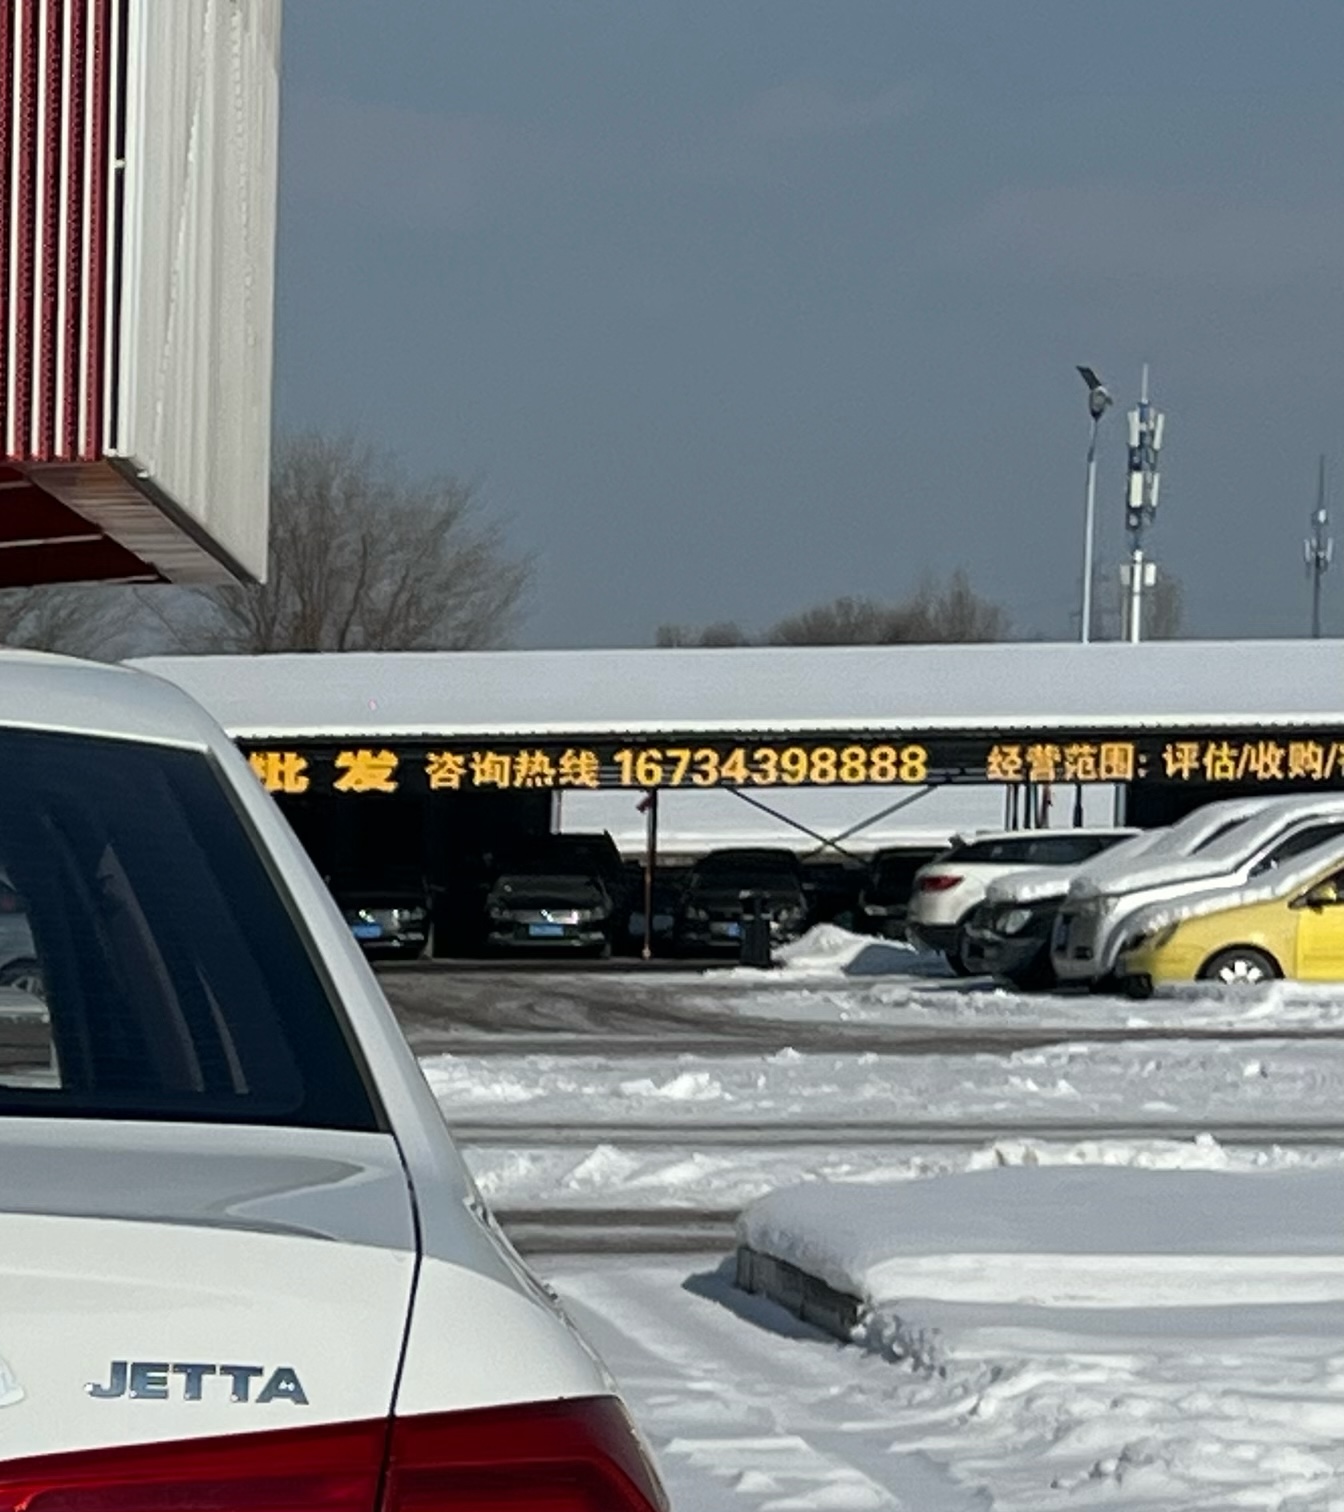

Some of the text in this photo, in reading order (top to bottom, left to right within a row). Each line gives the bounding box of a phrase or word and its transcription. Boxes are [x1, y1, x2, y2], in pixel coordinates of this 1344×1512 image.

[424, 749, 600, 789] 咨询热线
[613, 744, 928, 787] 16734398888
[83, 1360, 310, 1405] JETTA
